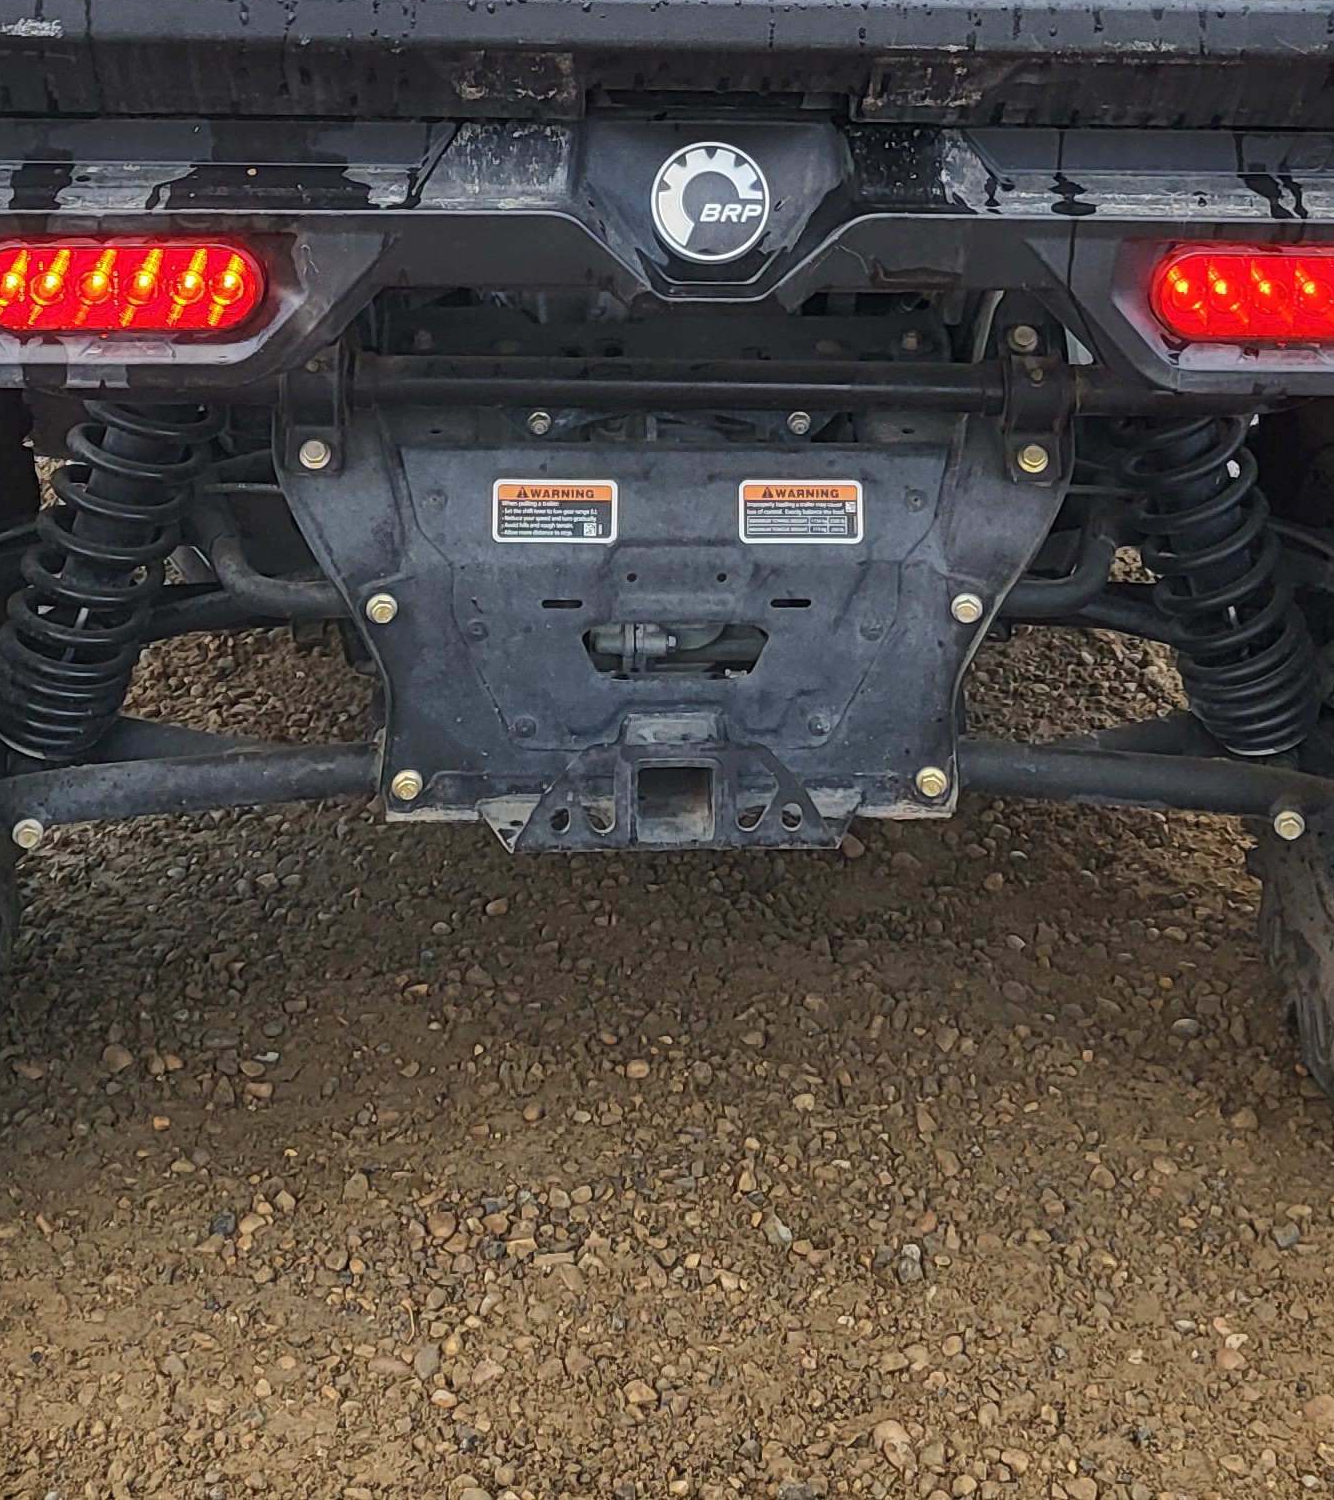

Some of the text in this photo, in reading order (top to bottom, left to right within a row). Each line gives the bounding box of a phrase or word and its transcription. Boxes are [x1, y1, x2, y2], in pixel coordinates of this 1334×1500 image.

[699, 203, 763, 223] BRP
[530, 489, 595, 499] WARNING
[775, 489, 840, 498] WARNING
